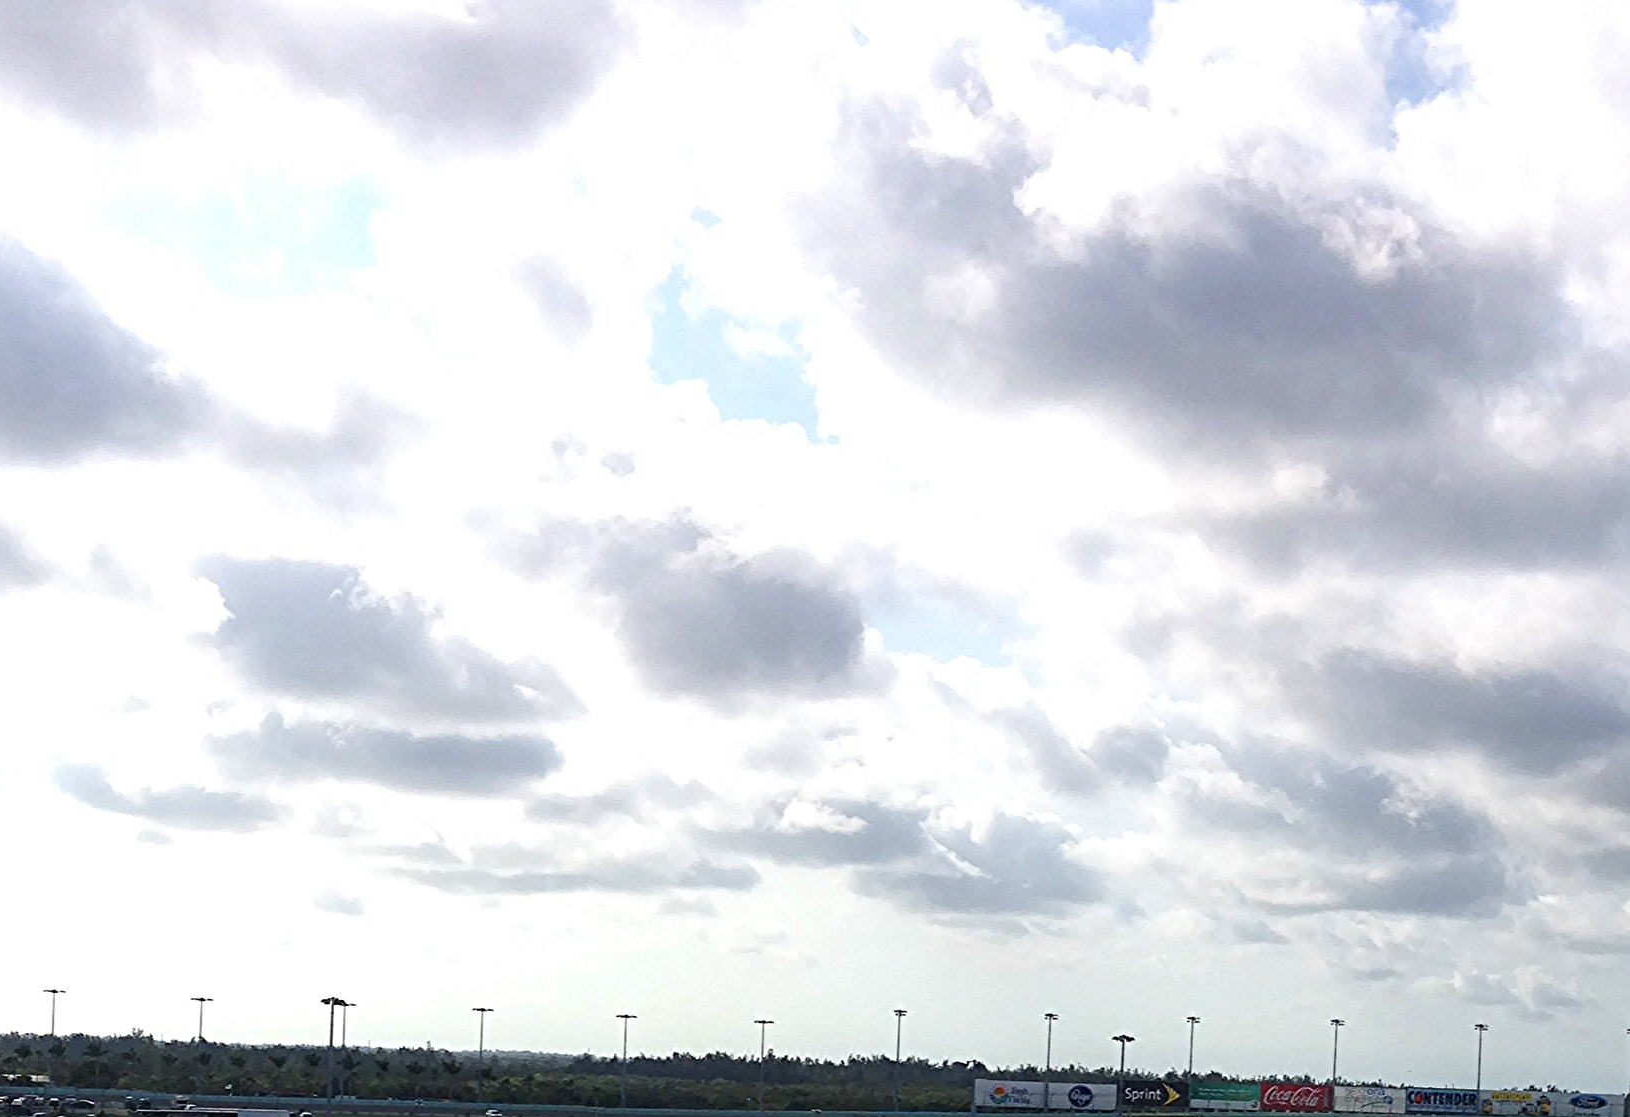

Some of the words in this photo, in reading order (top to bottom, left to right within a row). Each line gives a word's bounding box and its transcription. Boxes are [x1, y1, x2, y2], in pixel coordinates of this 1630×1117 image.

[1124, 1088, 1161, 1105] Sprint
[1263, 1086, 1321, 1108] Coca-Cola
[1407, 1091, 1477, 1106] CONTENDER
